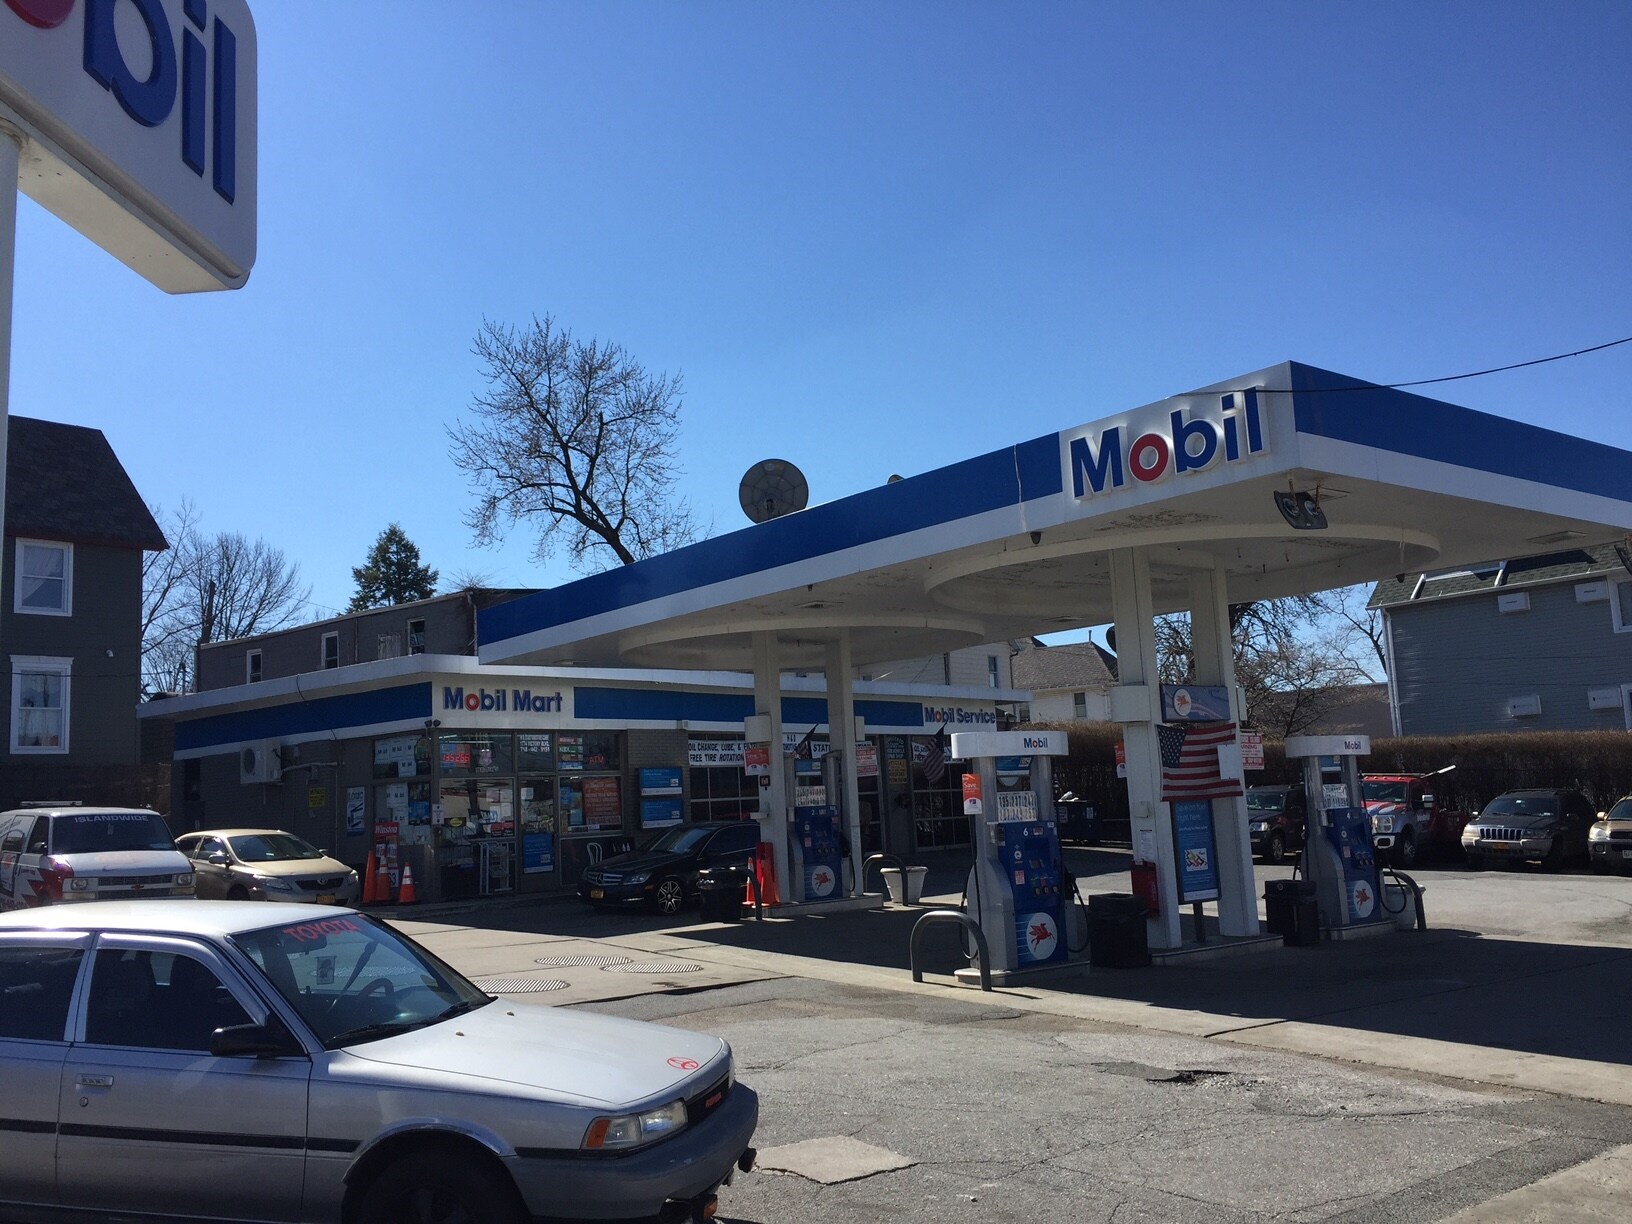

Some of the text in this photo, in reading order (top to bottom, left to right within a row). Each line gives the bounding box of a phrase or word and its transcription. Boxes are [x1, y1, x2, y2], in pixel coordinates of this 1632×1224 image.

[1069, 385, 1264, 499] Mobil
[442, 686, 563, 713] Mobil Mart
[924, 707, 996, 724] Mobil Service
[688, 743, 697, 751] OIL
[698, 743, 719, 752] CHANGE,
[1024, 737, 1049, 749] Mobil
[1344, 741, 1362, 750] Mobil
[689, 753, 745, 762] FREE TIRE ROTATION
[74, 815, 149, 823] ISLANDWIDE
[374, 825, 398, 834] Winston
[1023, 827, 1029, 837] 6
[282, 919, 361, 942] TOYOTA
